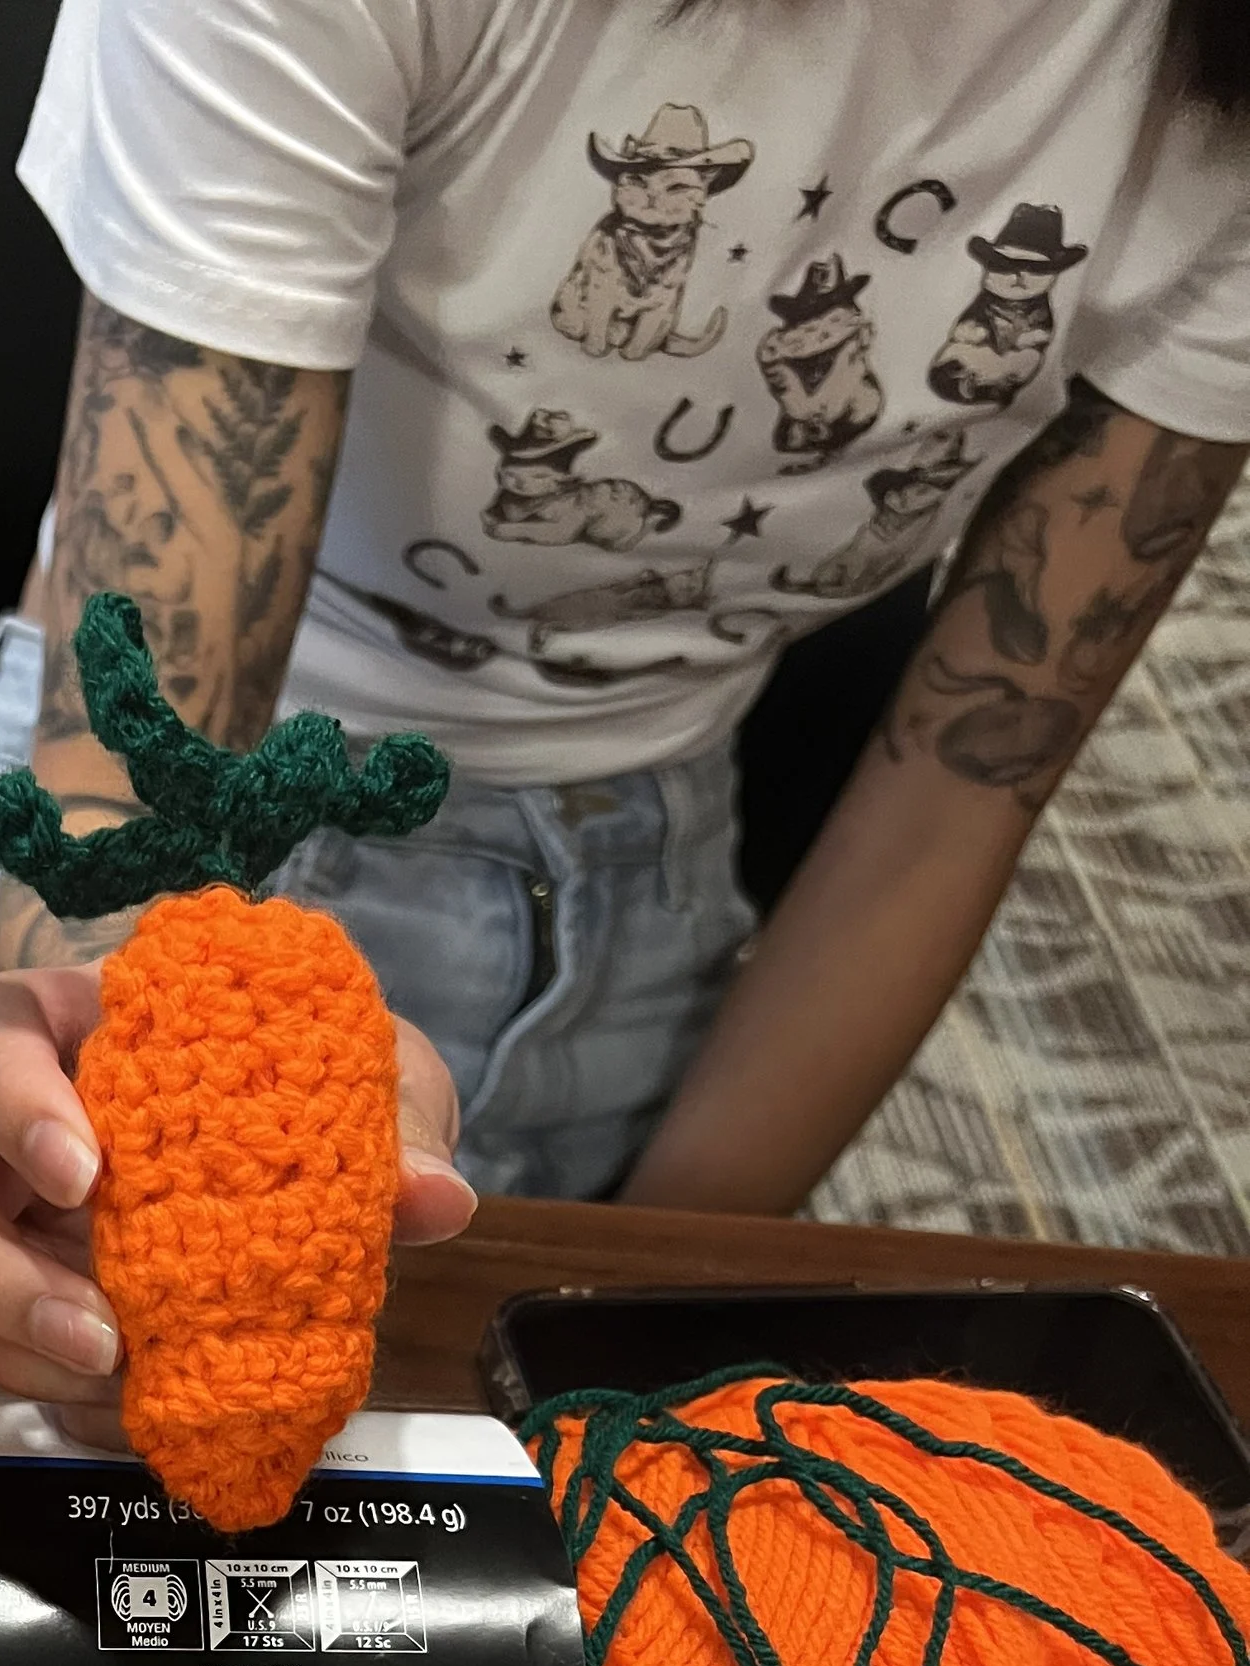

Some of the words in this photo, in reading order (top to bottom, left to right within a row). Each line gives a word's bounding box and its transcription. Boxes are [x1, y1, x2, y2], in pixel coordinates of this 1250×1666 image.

[67, 1494, 110, 1519] 397
[120, 1495, 160, 1525] yds
[300, 1500, 314, 1522] 7
[324, 1504, 352, 1523] oz
[358, 1501, 435, 1527] (198.4
[441, 1503, 467, 1533] g)
[122, 1563, 170, 1573] MEDIUM
[227, 1564, 240, 1572] 10
[244, 1564, 252, 1572] x
[254, 1564, 268, 1572] 10
[271, 1564, 289, 1572] cm
[336, 1565, 350, 1573] 10
[353, 1565, 360, 1573] x
[364, 1565, 378, 1573] 10
[380, 1565, 399, 1573] cm
[241, 1578, 255, 1588] 5.5
[257, 1578, 277, 1588] mm
[349, 1580, 365, 1590] 5.5
[366, 1580, 387, 1590] mm
[143, 1589, 157, 1606] 4
[213, 1608, 223, 1619] in
[126, 1623, 171, 1633] MOYEN
[247, 1620, 266, 1631] U.S.
[268, 1620, 277, 1631] 9
[131, 1636, 169, 1647] Medio
[243, 1636, 258, 1648] 17
[262, 1636, 285, 1648] Sts
[355, 1637, 370, 1648] 12
[374, 1637, 391, 1648] Sc
